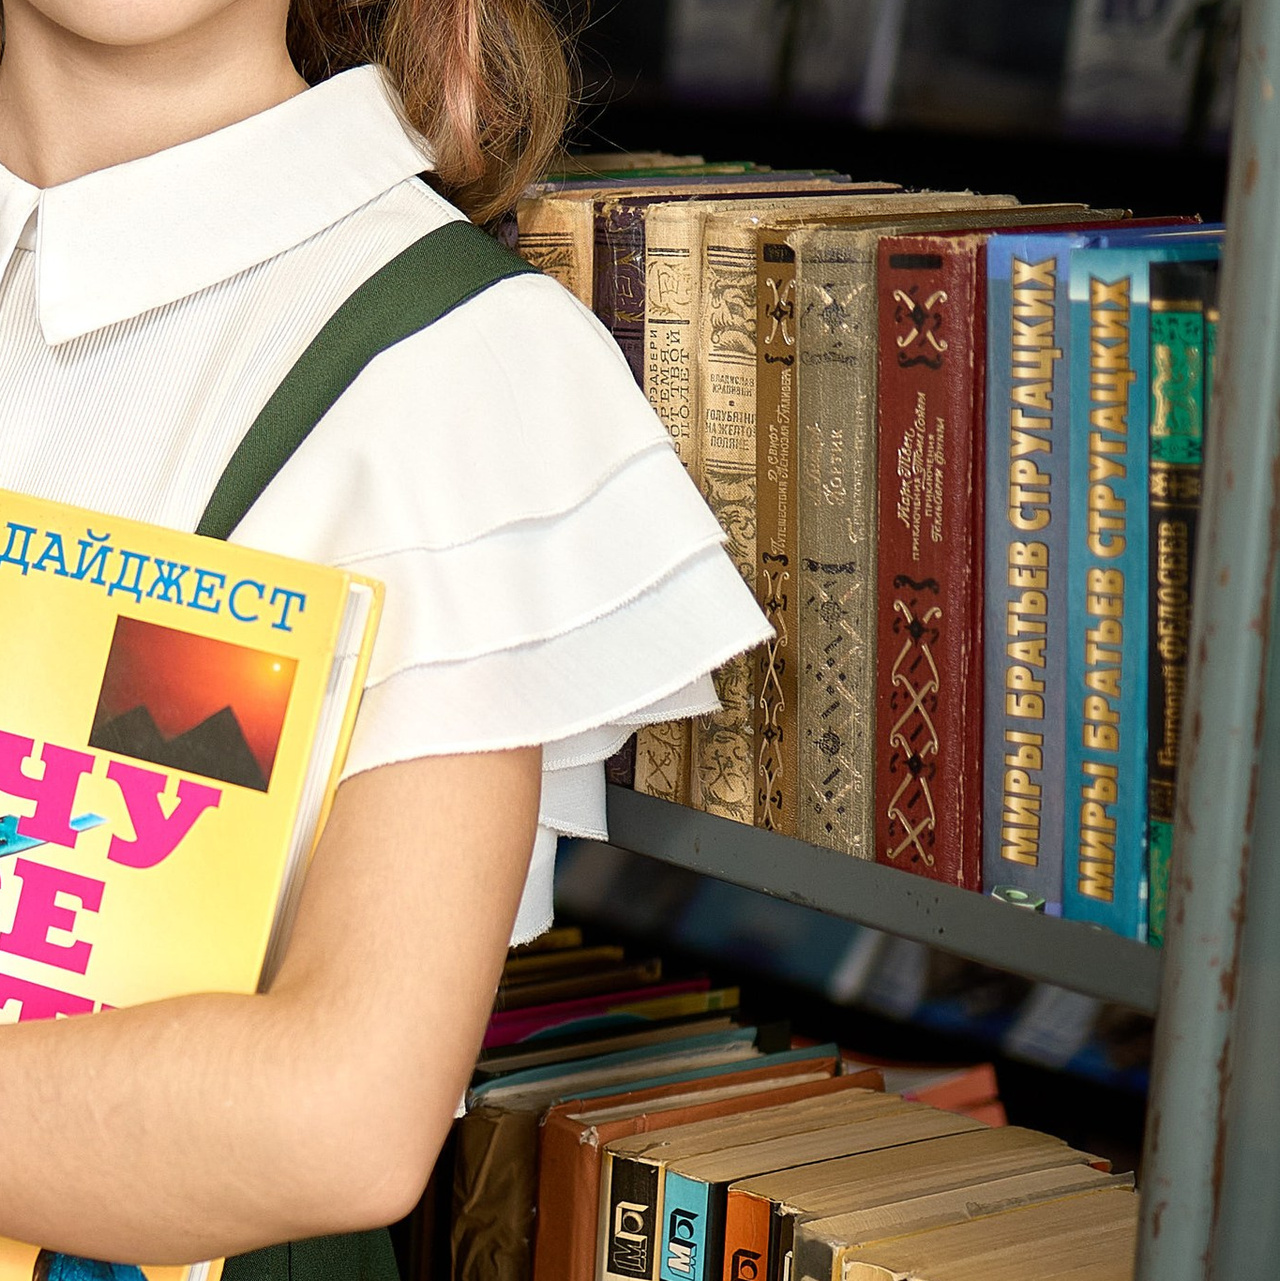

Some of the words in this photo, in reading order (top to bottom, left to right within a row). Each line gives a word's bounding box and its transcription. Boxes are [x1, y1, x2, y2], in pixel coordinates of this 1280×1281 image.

[666, 330, 680, 398] ТВОЙ
[680, 348, 690, 438] ПОЛЕТ
[1006, 254, 1063, 533] СТРУГАЦКИХ
[1085, 276, 1137, 560] СТРУГАЦКИХ
[705, 422, 716, 433] НА
[897, 427, 915, 478] Твен
[924, 434, 935, 517] ПРИКЛЮЧЕНИЯ
[897, 478, 913, 528] Марк
[912, 478, 921, 561] ПРИКЛЮЧЕНИЯ
[1003, 541, 1050, 723] БРАТЬЕВ
[1156, 519, 1189, 661] ФЕДОСЕЕВ
[1081, 568, 1128, 754] БРАТЬЕВ
[1000, 729, 1044, 868] МИРЫ
[1077, 762, 1120, 903] МИРЫ
